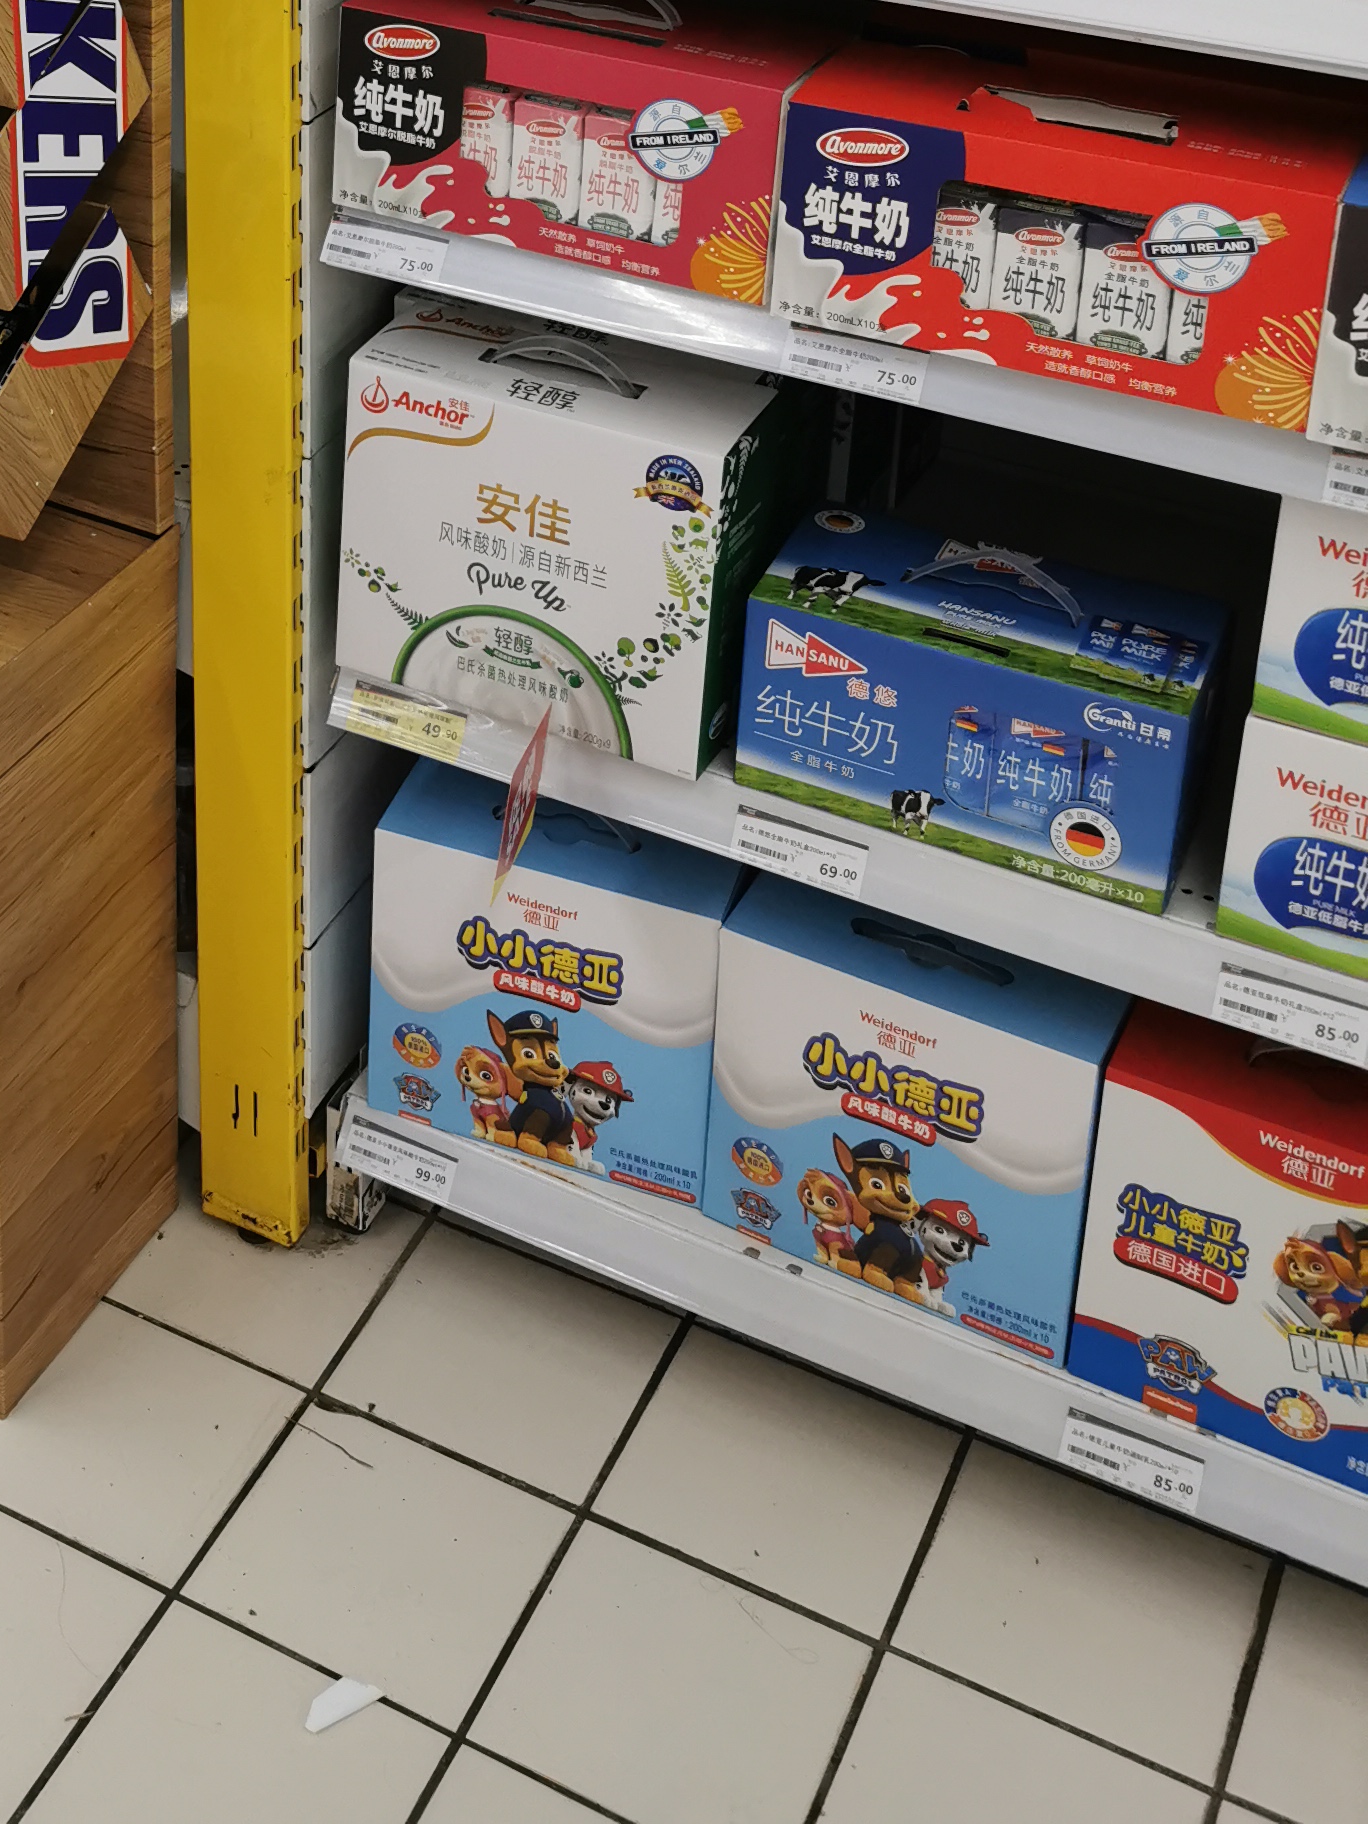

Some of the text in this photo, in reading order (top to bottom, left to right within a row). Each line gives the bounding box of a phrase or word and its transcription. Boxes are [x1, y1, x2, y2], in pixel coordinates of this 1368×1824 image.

[371, 60, 434, 80] 艾恩摩尔
[353, 76, 444, 138] 纯牛奶
[636, 130, 714, 147] FROM IRELAND
[824, 165, 901, 188] 艾恩摩尔
[803, 182, 910, 250] 纯牛奶
[1151, 238, 1250, 255] FROM IRELAND
[506, 376, 580, 410] 轻醇
[876, 370, 918, 387] 75.00
[391, 390, 470, 426] Anchor
[476, 482, 572, 546] 安佳
[438, 520, 608, 590] 风味酸奶 源自新西兰
[466, 562, 566, 613] Pure Up
[845, 677, 898, 708] 德悠
[753, 683, 898, 766] 纯牛奶
[789, 749, 856, 780] 全脂牛奶
[819, 862, 858, 882] 69.00
[507, 890, 579, 921] Weidendorf
[522, 908, 560, 932] 德亚
[461, 917, 622, 999] 小小德亚
[499, 970, 578, 1008] 风味酸牛奶
[859, 1009, 937, 1051] Weidendorf
[1314, 1023, 1360, 1045] 85.00
[809, 1033, 984, 1138] 小小德亚
[848, 1095, 932, 1143] 风味酸牛奶
[1259, 1129, 1366, 1180] Weidendorf
[1281, 1154, 1335, 1191] 德亚
[415, 1166, 447, 1186] 99.00
[1123, 1187, 1238, 1241] 小小德亚
[1122, 1216, 1231, 1268] 儿童牛奶
[1126, 1240, 1227, 1295] 德国进口
[1140, 1338, 1216, 1384] PAW
